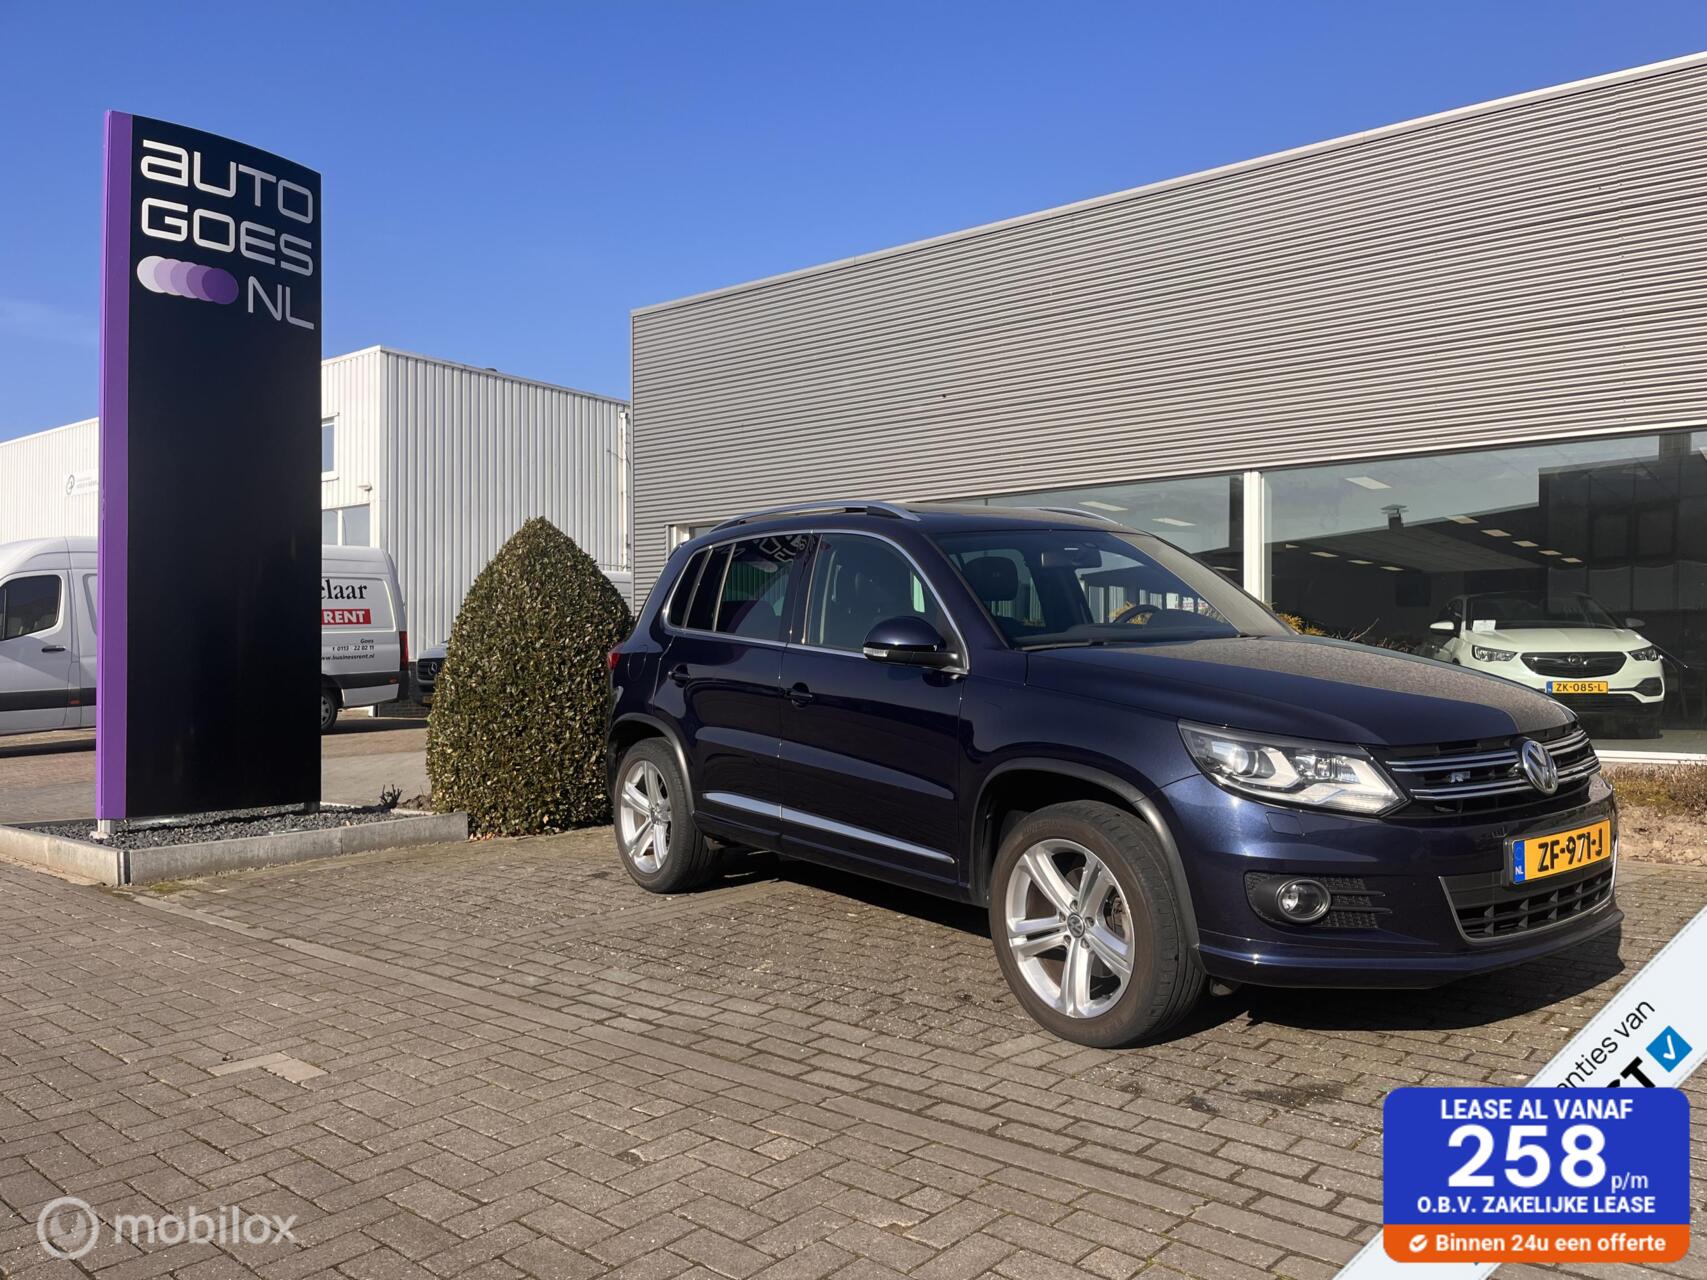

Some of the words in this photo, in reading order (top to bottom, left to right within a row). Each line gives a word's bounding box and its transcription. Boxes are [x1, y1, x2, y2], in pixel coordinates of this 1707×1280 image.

[142, 197, 314, 277] GOES
[248, 275, 314, 330] NL
[323, 610, 366, 624] RENT
[1556, 683, 1604, 692] ZK-085-L
[1538, 828, 1603, 872] ZF-971-J
[1515, 865, 1524, 876] NL
